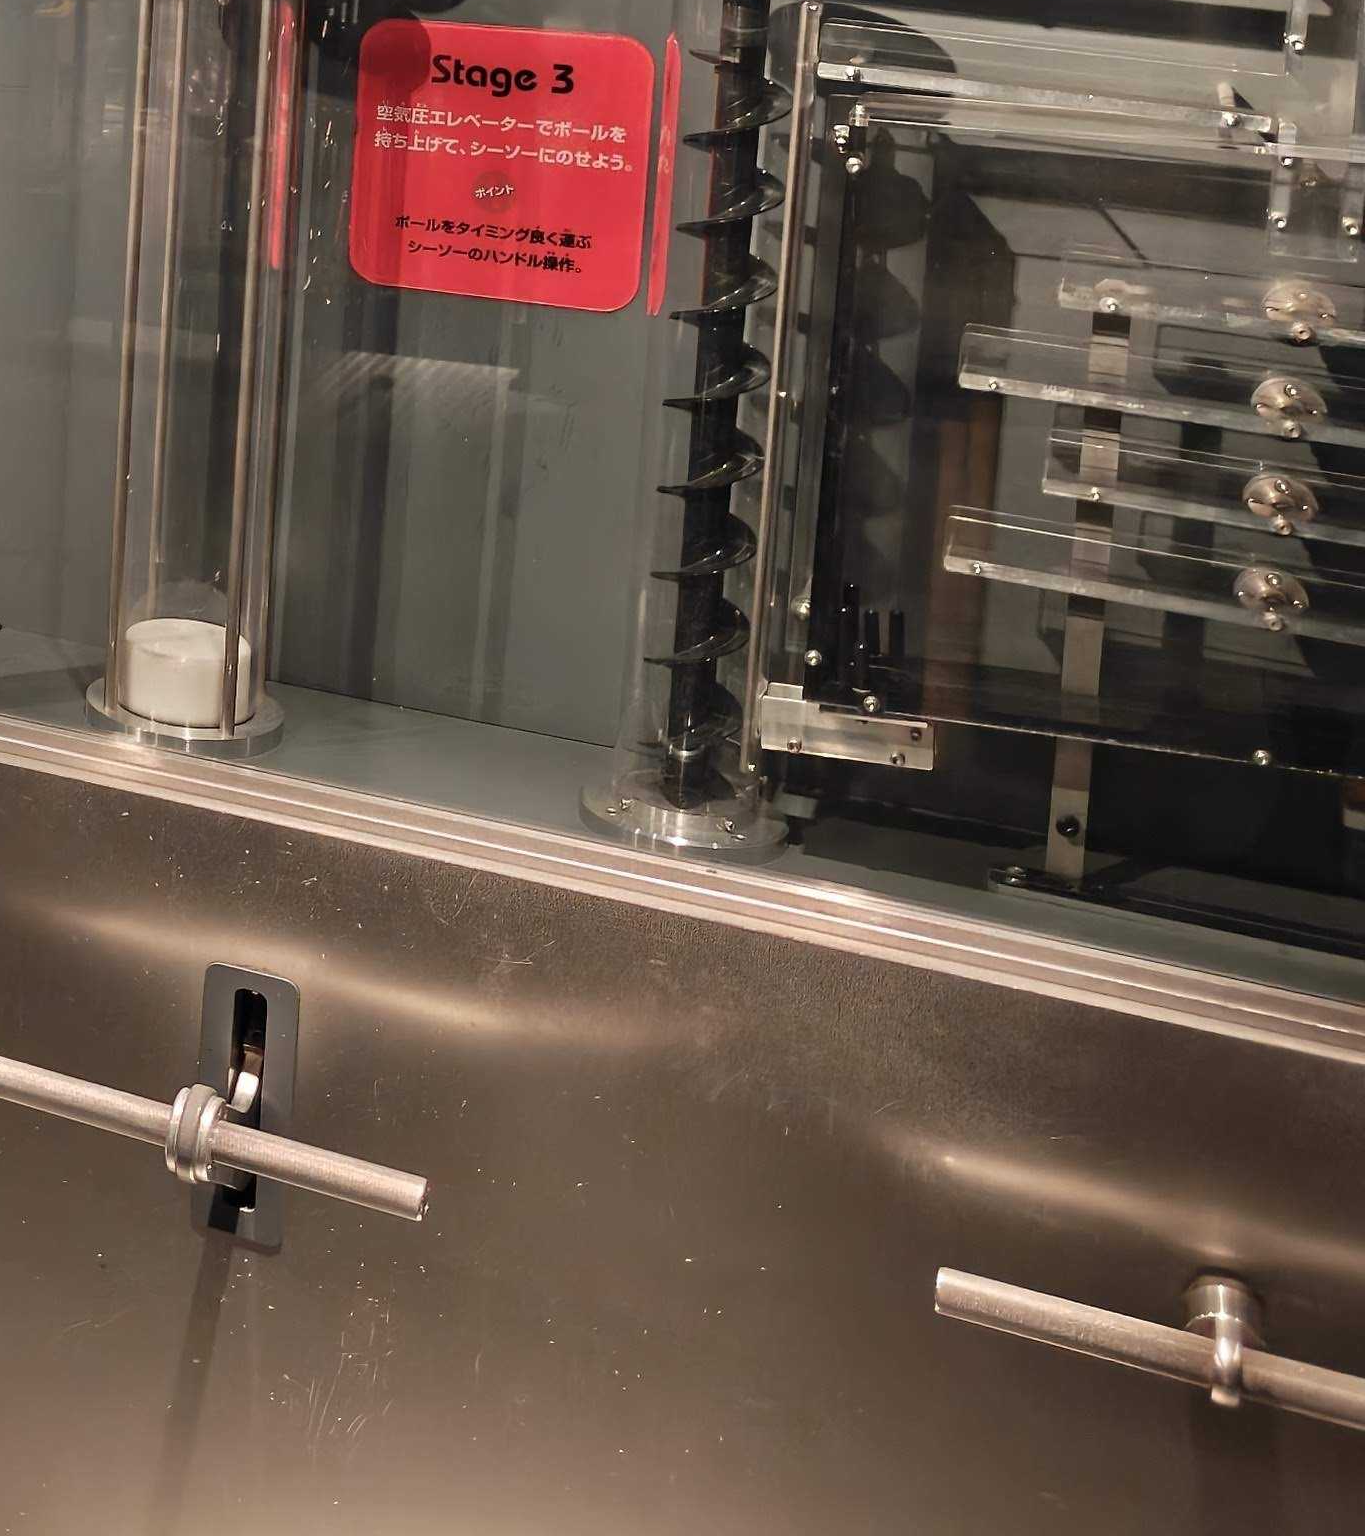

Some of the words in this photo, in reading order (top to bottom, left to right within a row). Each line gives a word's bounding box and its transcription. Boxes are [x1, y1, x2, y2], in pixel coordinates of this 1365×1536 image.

[432, 55, 537, 97] Stage
[551, 64, 574, 94] 3
[376, 104, 627, 144] 空気圧エレベーターでボールを
[374, 130, 634, 173] 持ち上げて、シーソーにのせよう。
[475, 184, 514, 199] ポイント
[408, 240, 582, 274] シーソーのハンドル操作。
